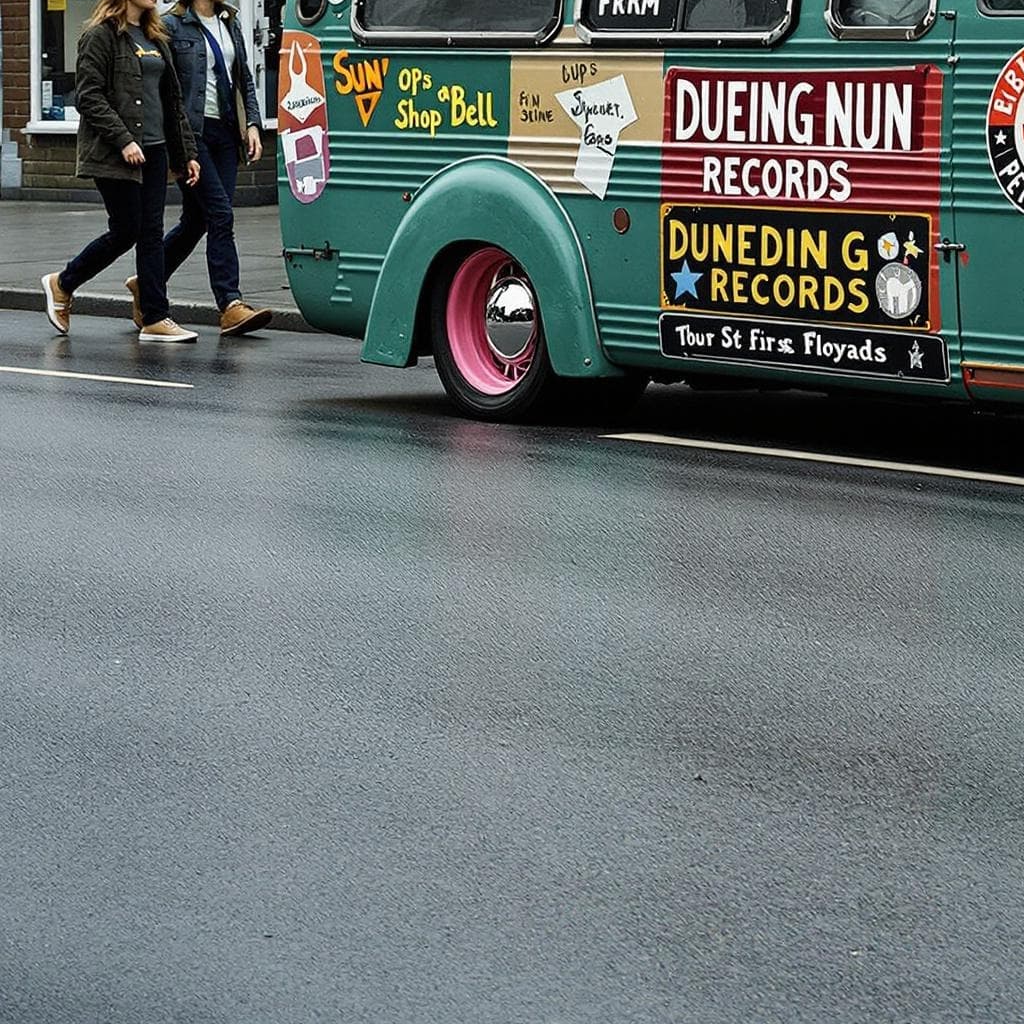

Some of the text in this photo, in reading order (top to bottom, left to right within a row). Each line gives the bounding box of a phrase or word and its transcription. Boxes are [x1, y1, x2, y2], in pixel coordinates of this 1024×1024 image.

[394, 98, 442, 138] Shop
[675, 78, 814, 145] DUEING
[825, 80, 913, 152] NUN
[702, 155, 852, 202] RECORDS
[668, 219, 828, 270] DUNEDIN
[710, 267, 870, 314] RECORDS
[721, 326, 742, 350] St
[803, 331, 888, 365] Floyads
